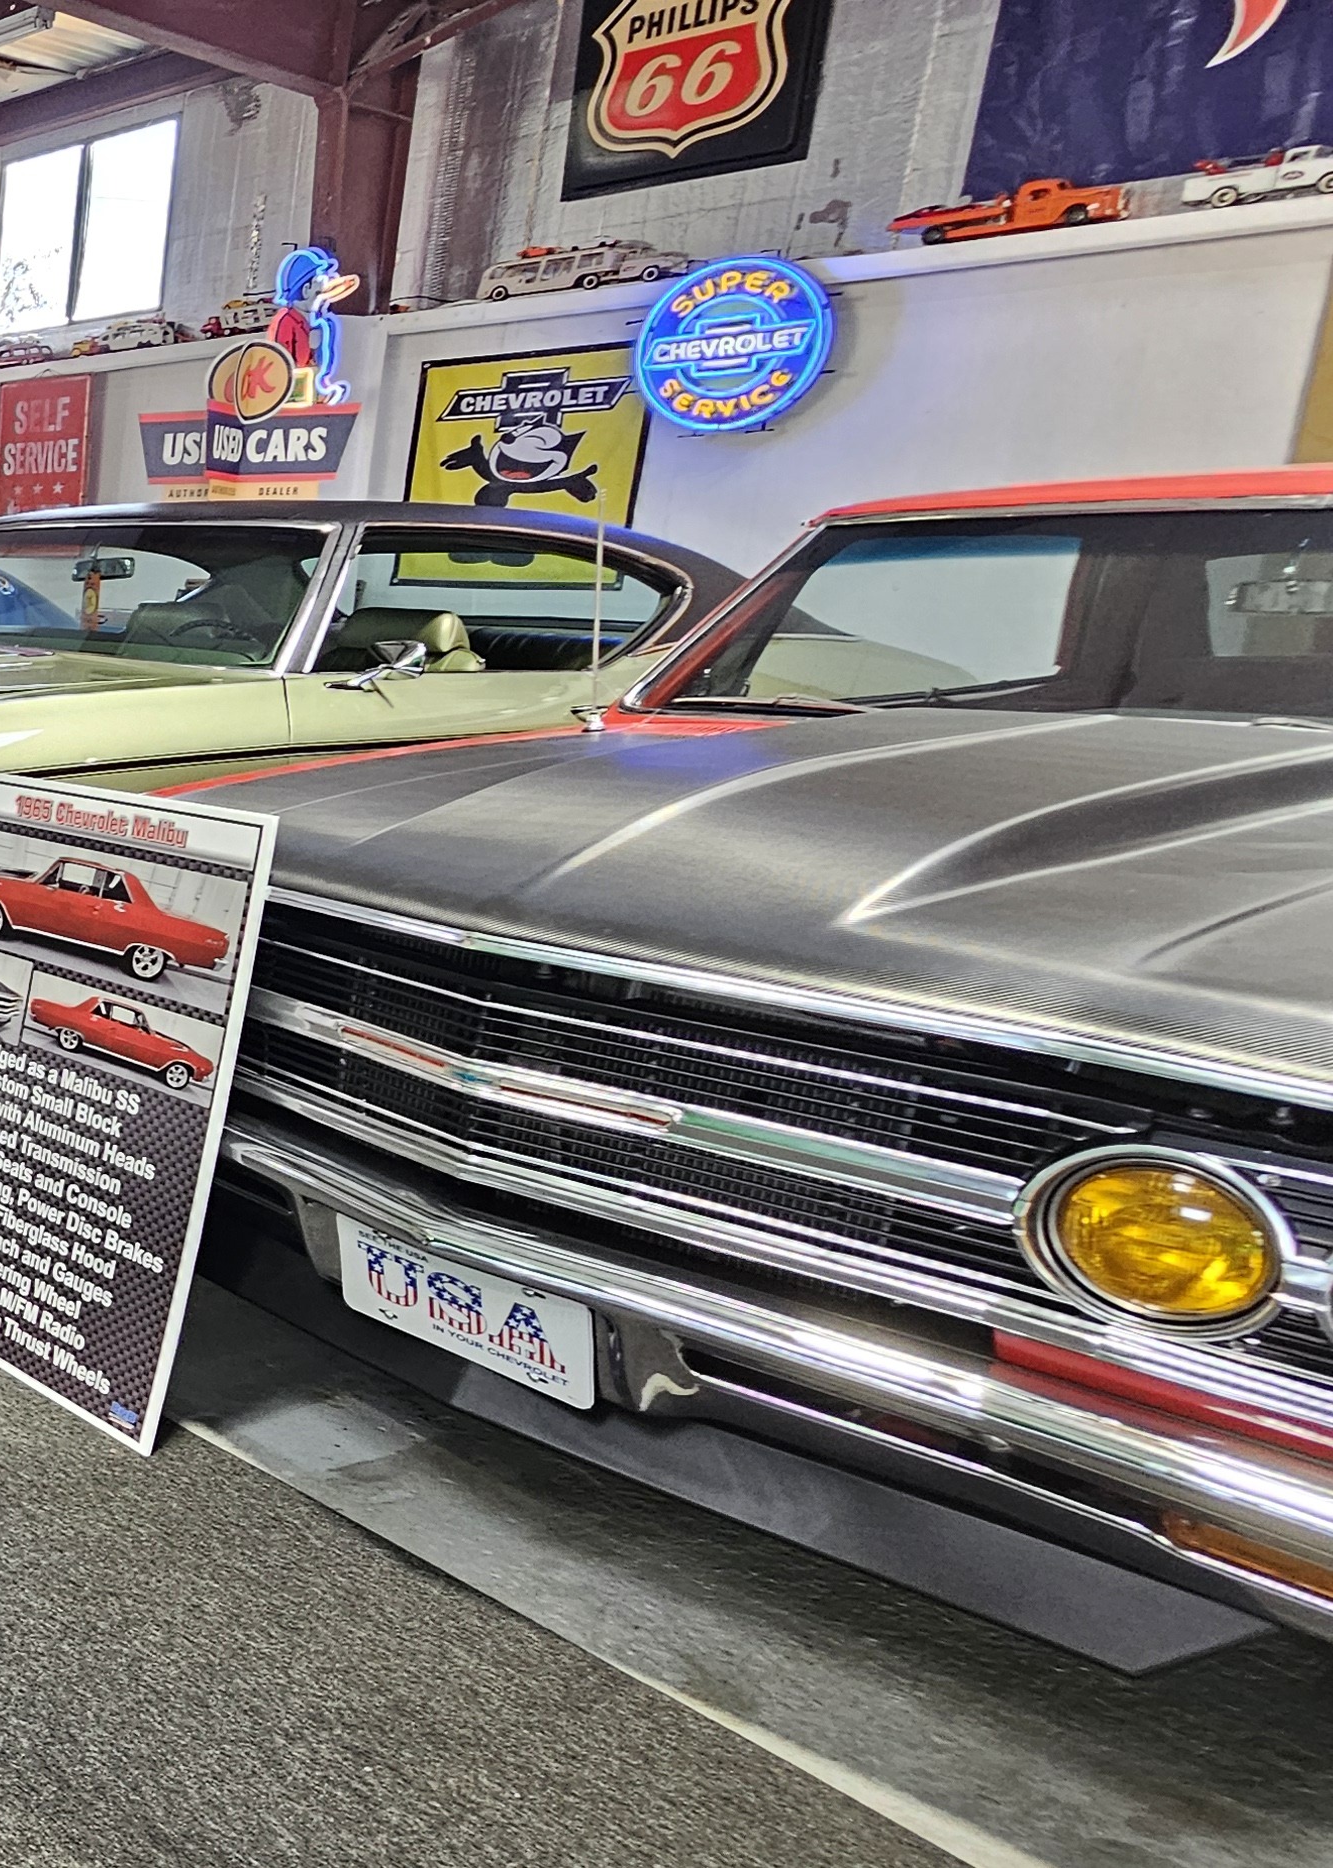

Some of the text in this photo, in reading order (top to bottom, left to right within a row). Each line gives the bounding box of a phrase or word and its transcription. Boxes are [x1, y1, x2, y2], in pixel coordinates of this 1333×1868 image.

[628, 0, 759, 43] PHILLIPS
[625, 40, 742, 117] 66
[671, 268, 796, 317] SUPER
[653, 326, 806, 363] CHEVROLET
[14, 396, 70, 434] SELF
[459, 385, 610, 414] CHEVROLET
[658, 368, 794, 418] SERVICE
[2, 438, 79, 476] SERVICE
[213, 425, 327, 463] USED CARS
[258, 487, 298, 496] DEALER
[15, 794, 190, 848] 1965 Chevrolet Malibu
[27, 1061, 46, 1080] as
[48, 1069, 58, 1084] a
[60, 1068, 113, 1105] Malibu
[115, 1089, 141, 1116] SS
[30, 1086, 74, 1119] Small
[75, 1103, 124, 1138] Block
[20, 1133, 122, 1195] Transmission
[23, 1110, 100, 1158] Aluminum
[102, 1141, 156, 1181] Heads
[34, 1171, 65, 1198] and
[66, 1184, 133, 1229] Console
[18, 1188, 66, 1226] Power
[66, 1211, 103, 1244] Disc
[104, 1228, 165, 1275] Brakes
[380, 1237, 405, 1253] THE
[405, 1249, 429, 1263] USA
[21, 1249, 51, 1276] and
[52, 1261, 113, 1308] Gauges
[71, 1242, 117, 1280] Hood
[33, 1277, 82, 1320] Wheel
[357, 1240, 566, 1374] USA
[39, 1308, 85, 1351] Radio
[433, 1323, 570, 1386] IN YOUR CHEVROLET
[2, 1316, 52, 1362] Thrust
[52, 1344, 111, 1396] Wheels
